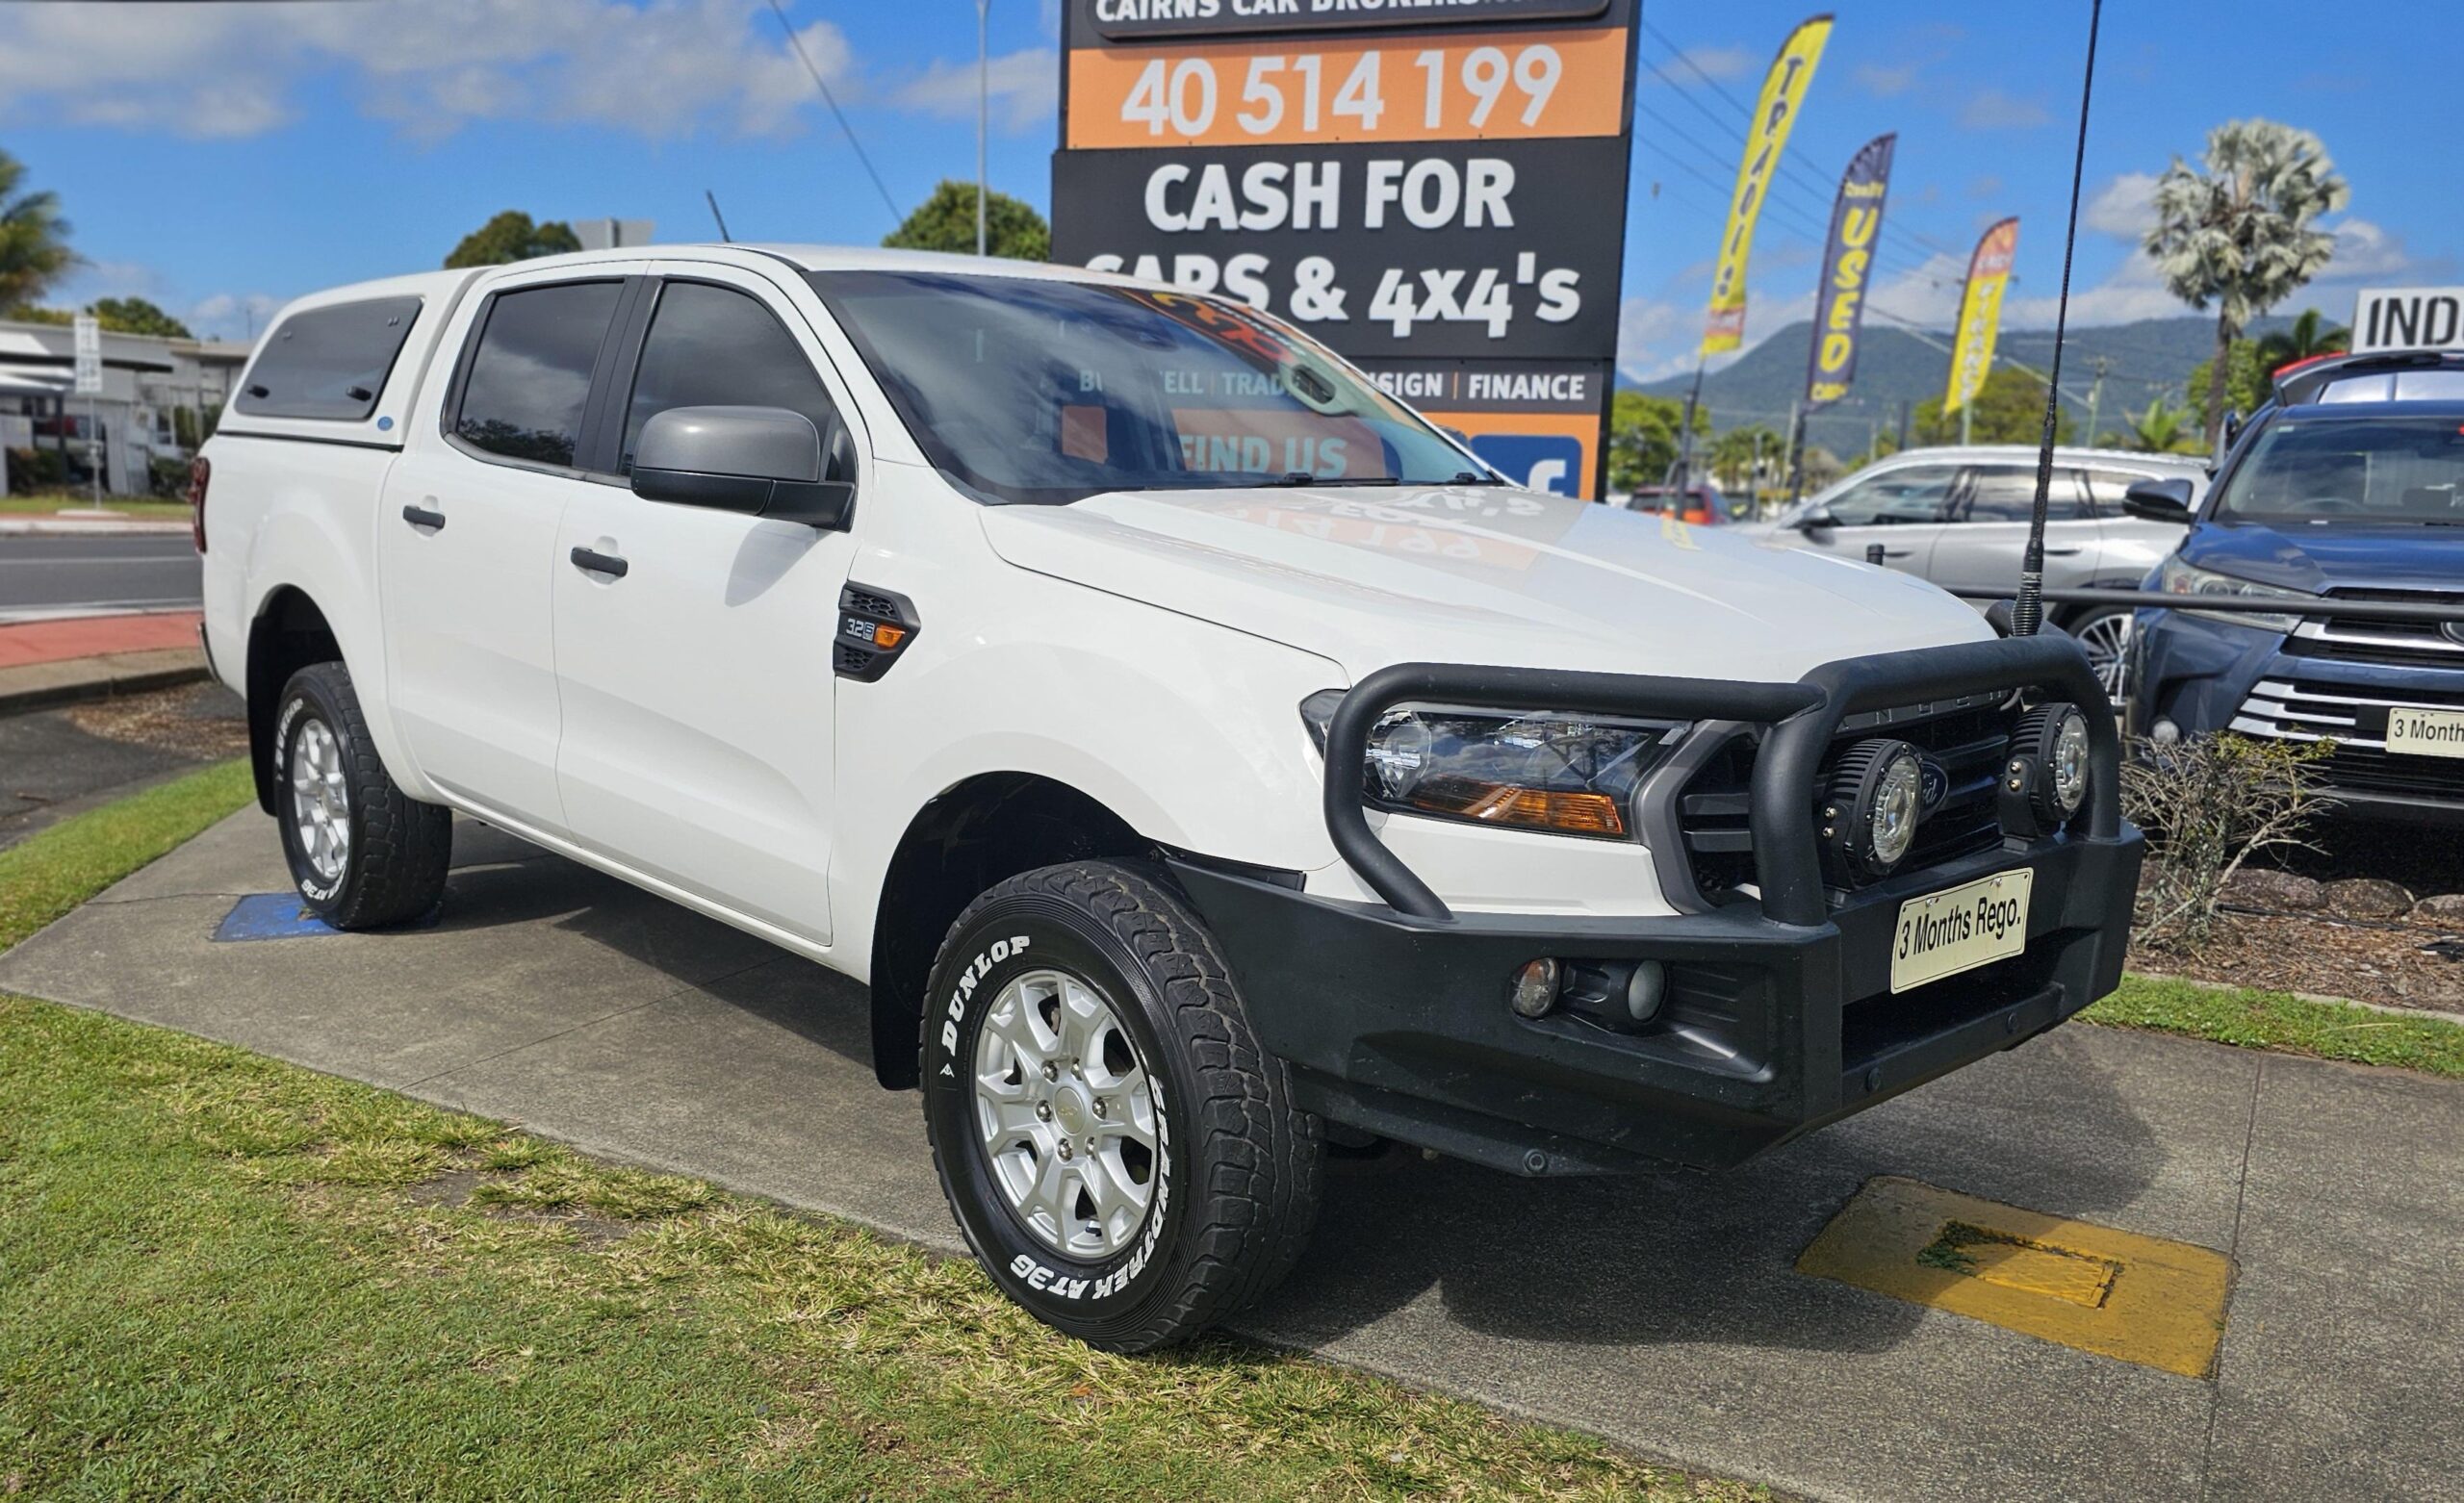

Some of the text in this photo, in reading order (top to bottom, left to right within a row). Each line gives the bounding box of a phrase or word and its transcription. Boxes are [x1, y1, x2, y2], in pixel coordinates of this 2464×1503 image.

[1120, 43, 1562, 137] 40 514 199
[1144, 158, 1515, 232] CASH FOR
[1290, 255, 1349, 322] &
[1819, 206, 1879, 372] USED
[2366, 295, 2464, 346] IND
[1159, 369, 1203, 395] ELL
[1221, 371, 1299, 396] TRAD
[1468, 373, 1586, 400] FINANCE
[1284, 437, 1348, 479] US
[2394, 719, 2404, 738] 3
[1899, 897, 2020, 960] 3 Months Rego.
[941, 935, 1031, 1057] DUNLOP
